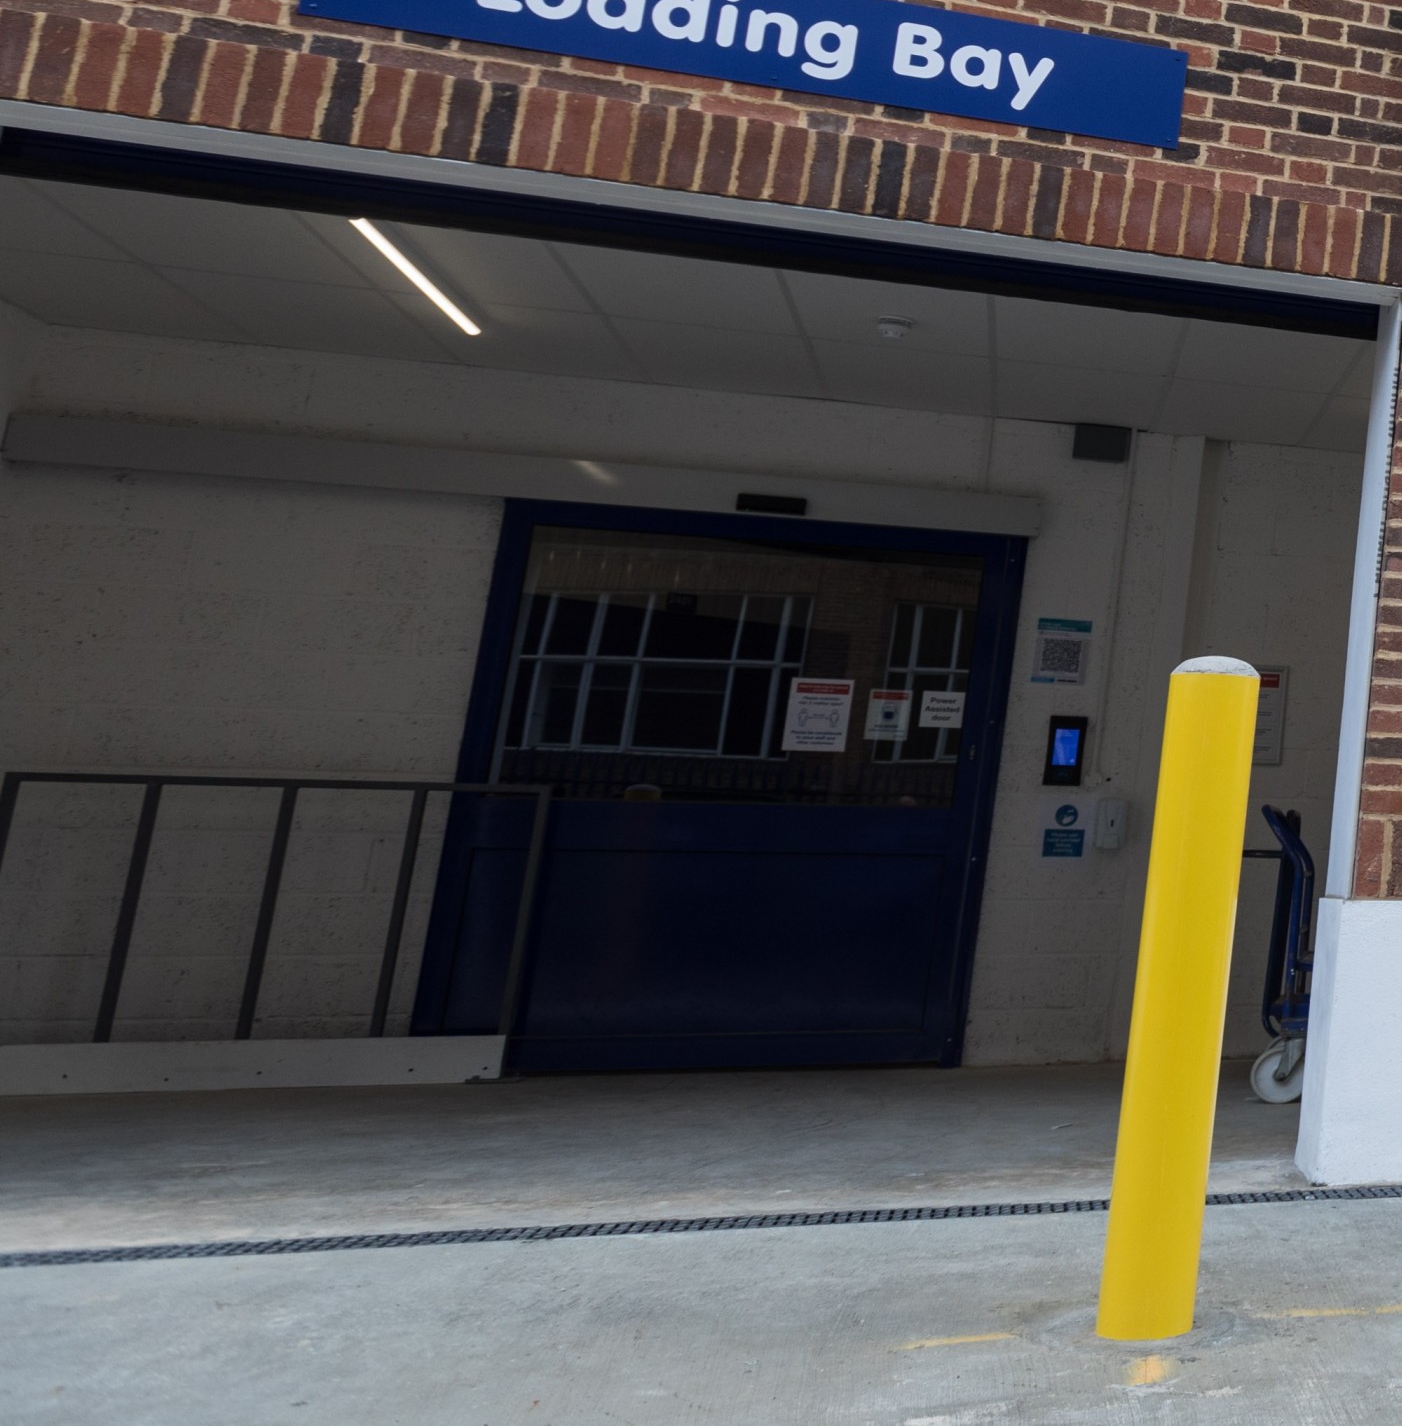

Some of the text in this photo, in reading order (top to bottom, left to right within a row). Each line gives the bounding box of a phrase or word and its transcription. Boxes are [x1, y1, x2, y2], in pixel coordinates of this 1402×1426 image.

[892, 22, 1056, 111] Bay
[930, 697, 957, 705] Power
[924, 705, 961, 714] Assisted
